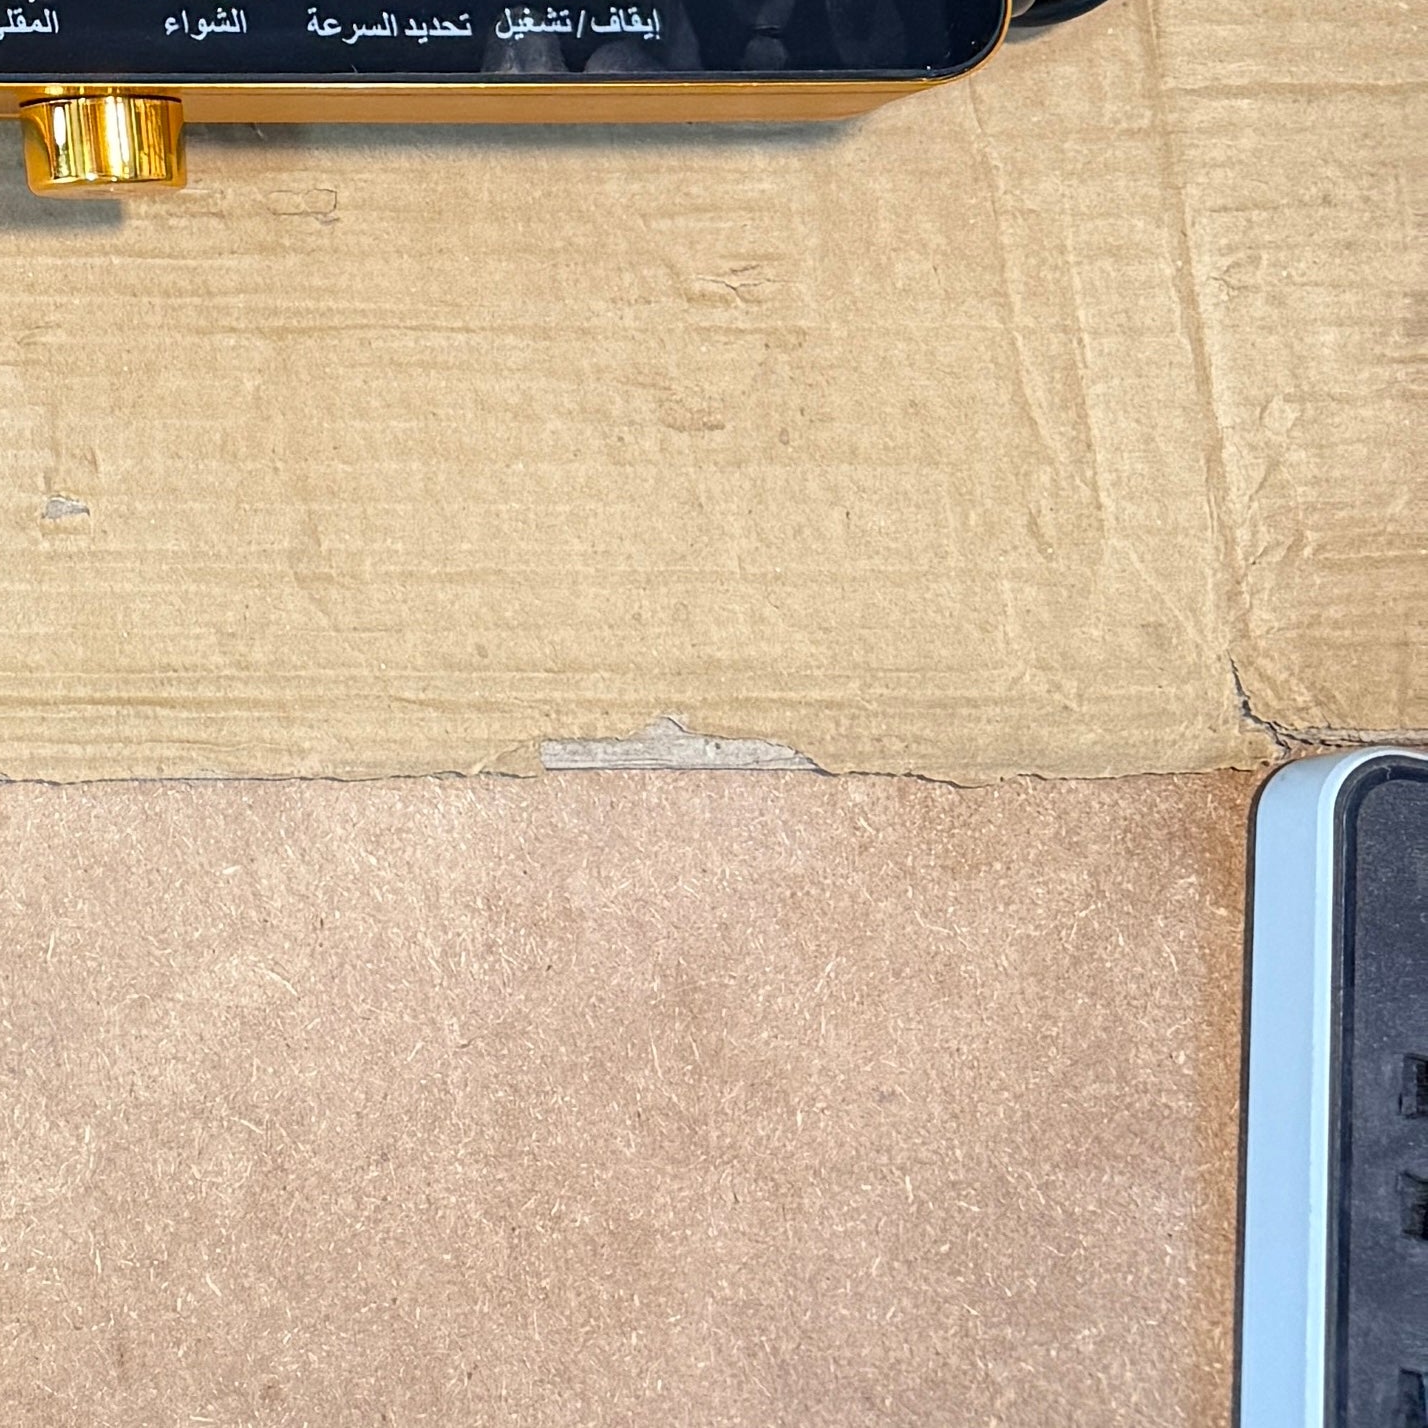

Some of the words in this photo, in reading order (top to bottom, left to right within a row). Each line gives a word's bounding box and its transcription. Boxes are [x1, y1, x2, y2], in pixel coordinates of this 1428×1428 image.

[164, 7, 247, 41] الشواء
[307, 7, 398, 45] السرعة
[404, 13, 473, 43] تحديد
